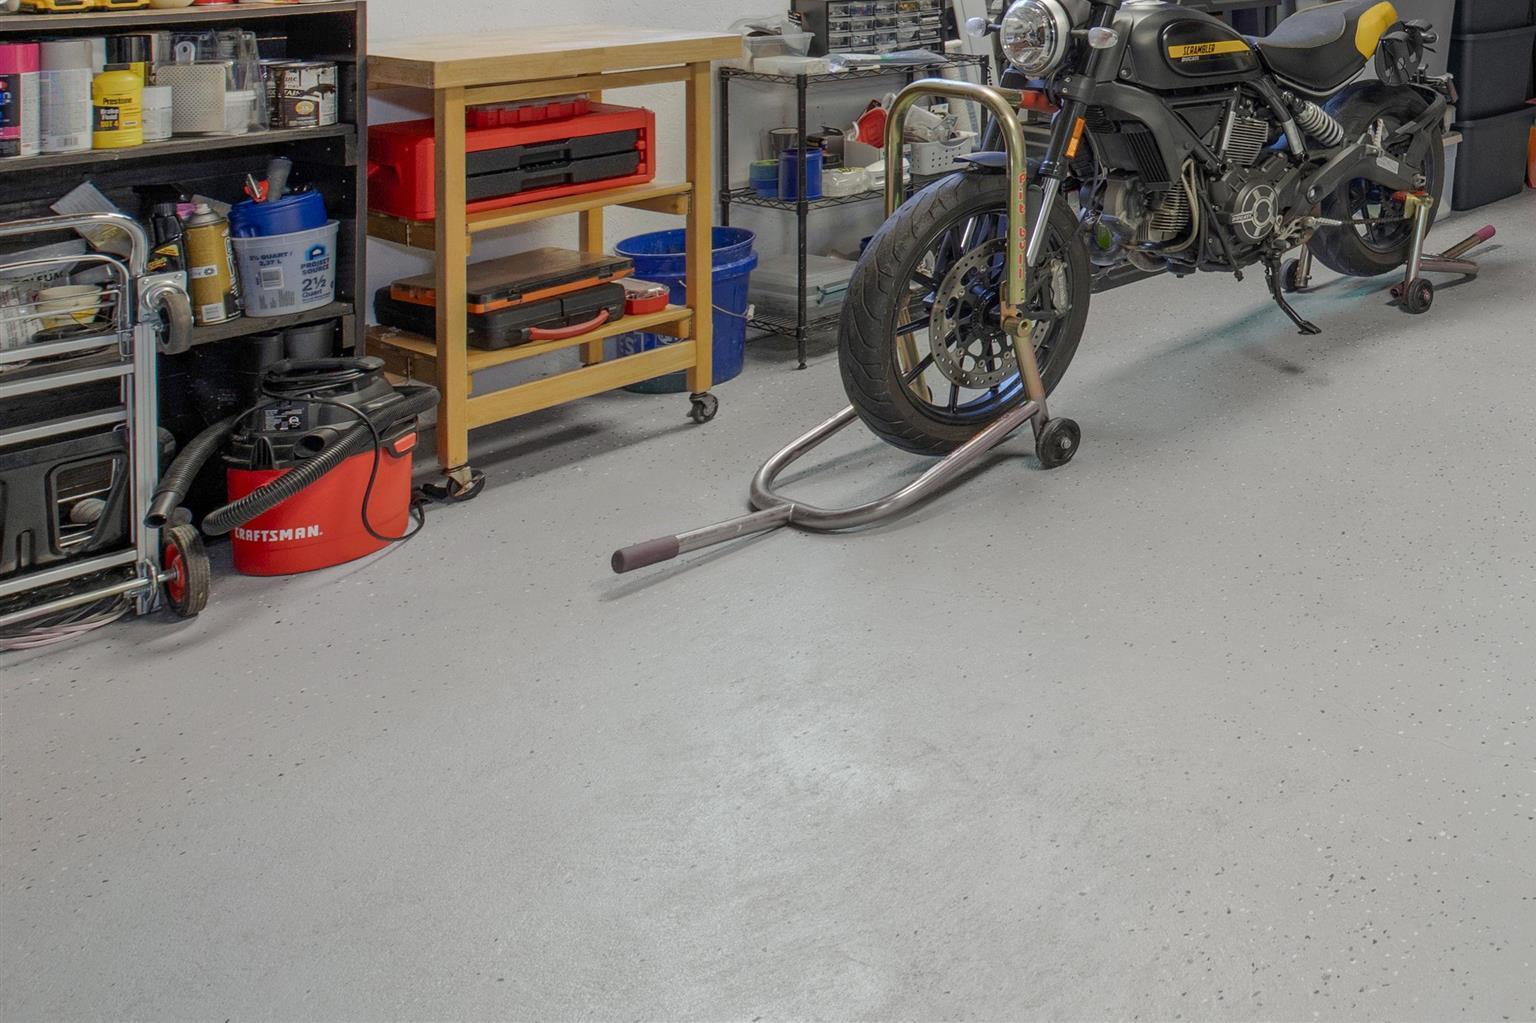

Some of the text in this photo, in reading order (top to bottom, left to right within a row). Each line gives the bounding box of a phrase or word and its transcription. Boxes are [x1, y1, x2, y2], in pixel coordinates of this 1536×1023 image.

[1183, 44, 1216, 56] SCRAMBLER
[102, 97, 133, 105] Prestone
[261, 251, 288, 260] QUART
[301, 257, 330, 269] PROJECT
[302, 264, 330, 275] SOURCE
[302, 288, 322, 298] Quart
[235, 525, 320, 543] CRAFTSMAN
